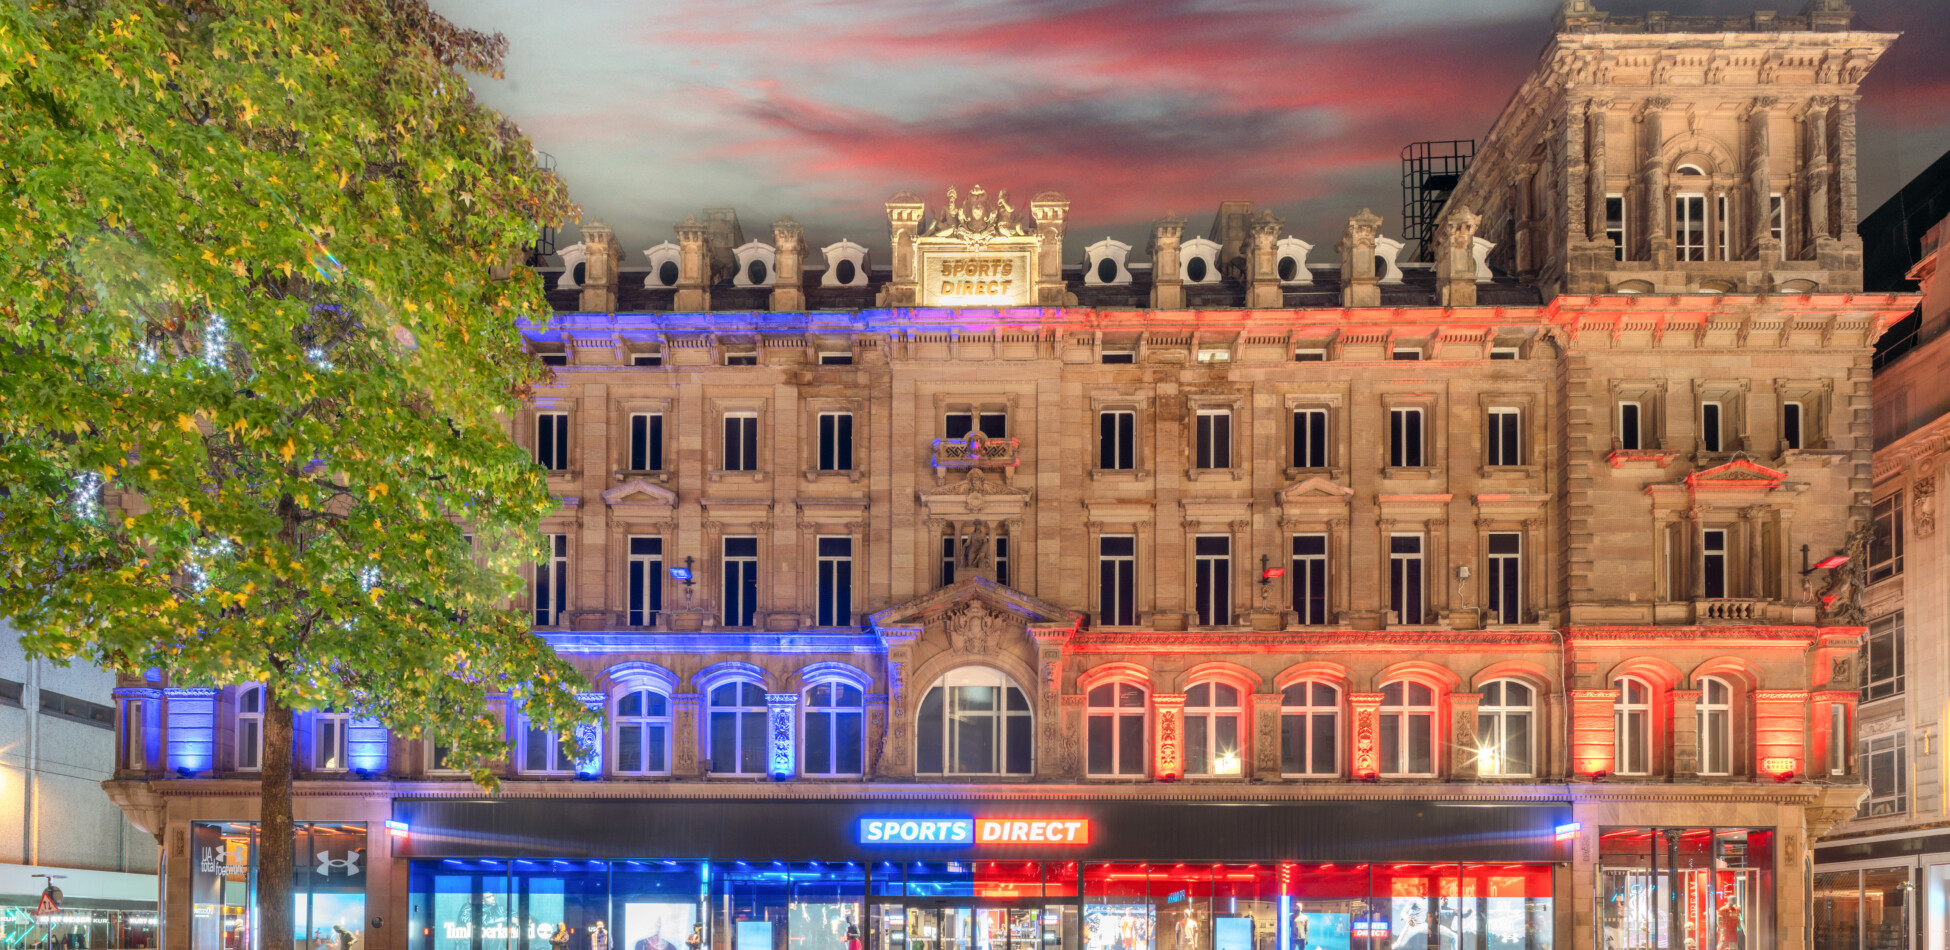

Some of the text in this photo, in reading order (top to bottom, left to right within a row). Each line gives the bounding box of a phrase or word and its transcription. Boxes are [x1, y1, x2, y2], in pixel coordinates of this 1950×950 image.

[941, 262, 1012, 277] SPORTS
[941, 280, 1012, 295] DIRECT
[868, 822, 1081, 841] SPORTS DIRECT
[201, 859, 215, 872] total
